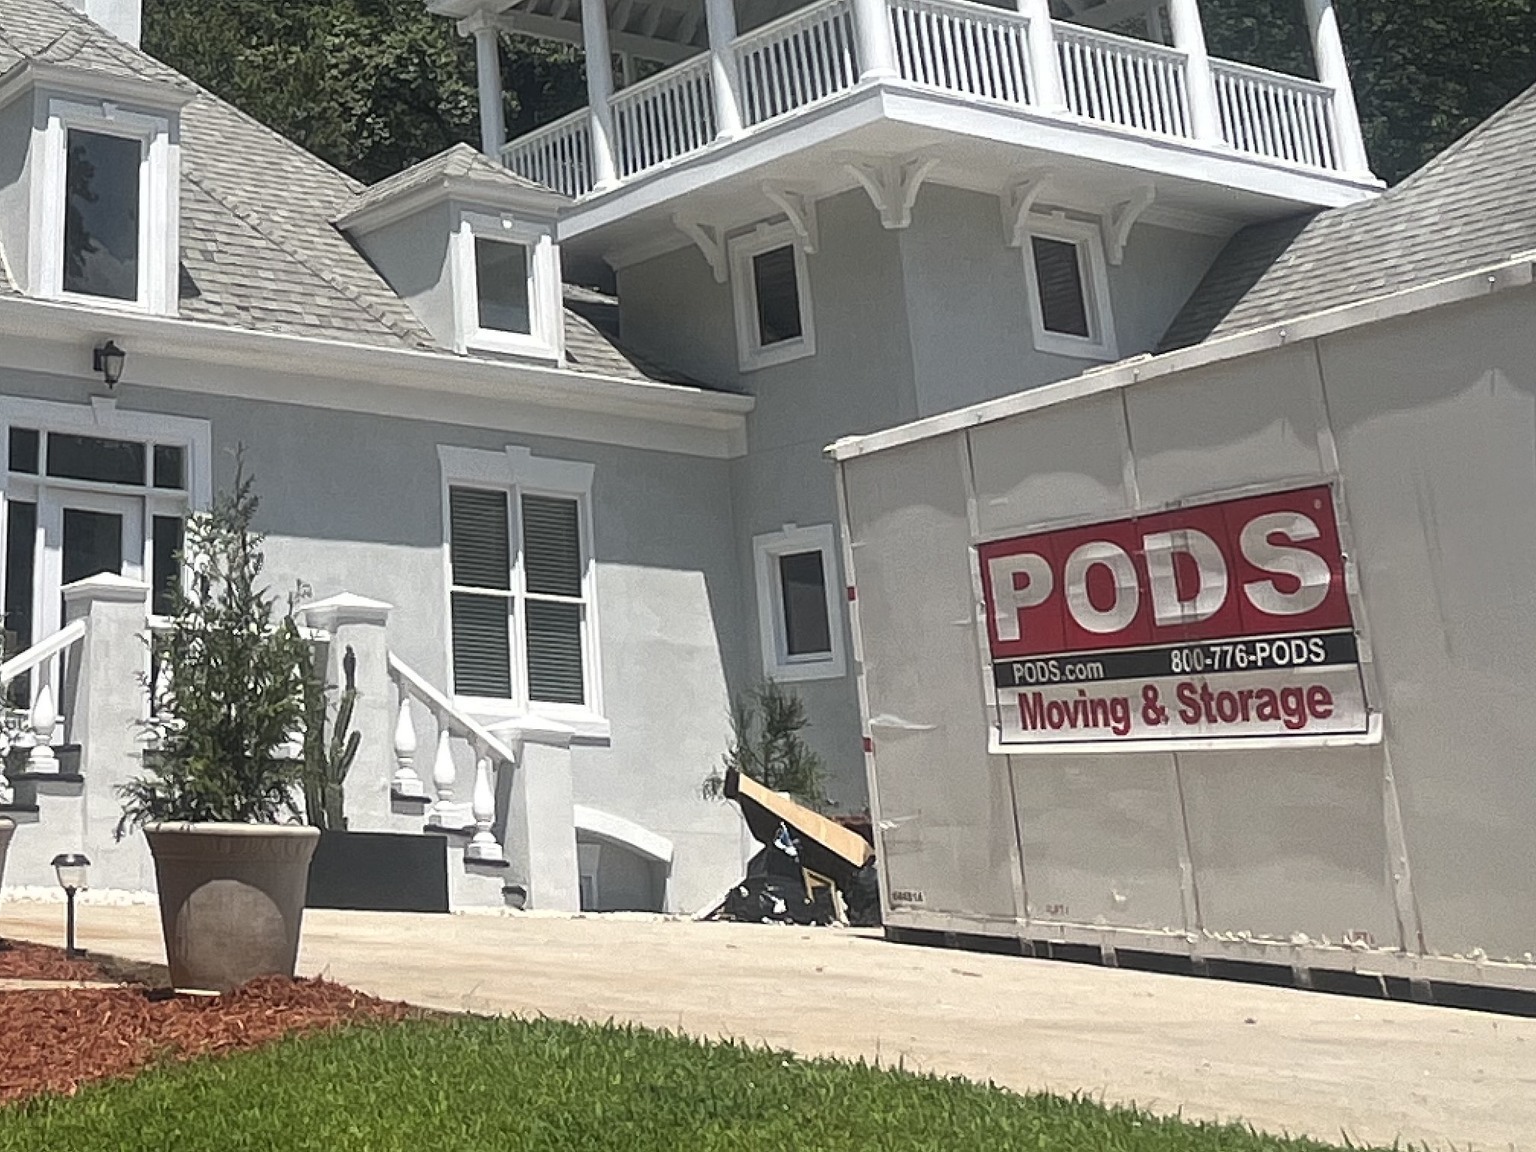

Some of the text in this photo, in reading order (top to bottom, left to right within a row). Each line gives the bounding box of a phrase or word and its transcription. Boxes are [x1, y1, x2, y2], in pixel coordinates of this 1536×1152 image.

[987, 510, 1332, 642] PODS
[1012, 637, 1326, 684] PODS.com 800-776-PODS
[1017, 682, 1334, 736] Moving & Storage
